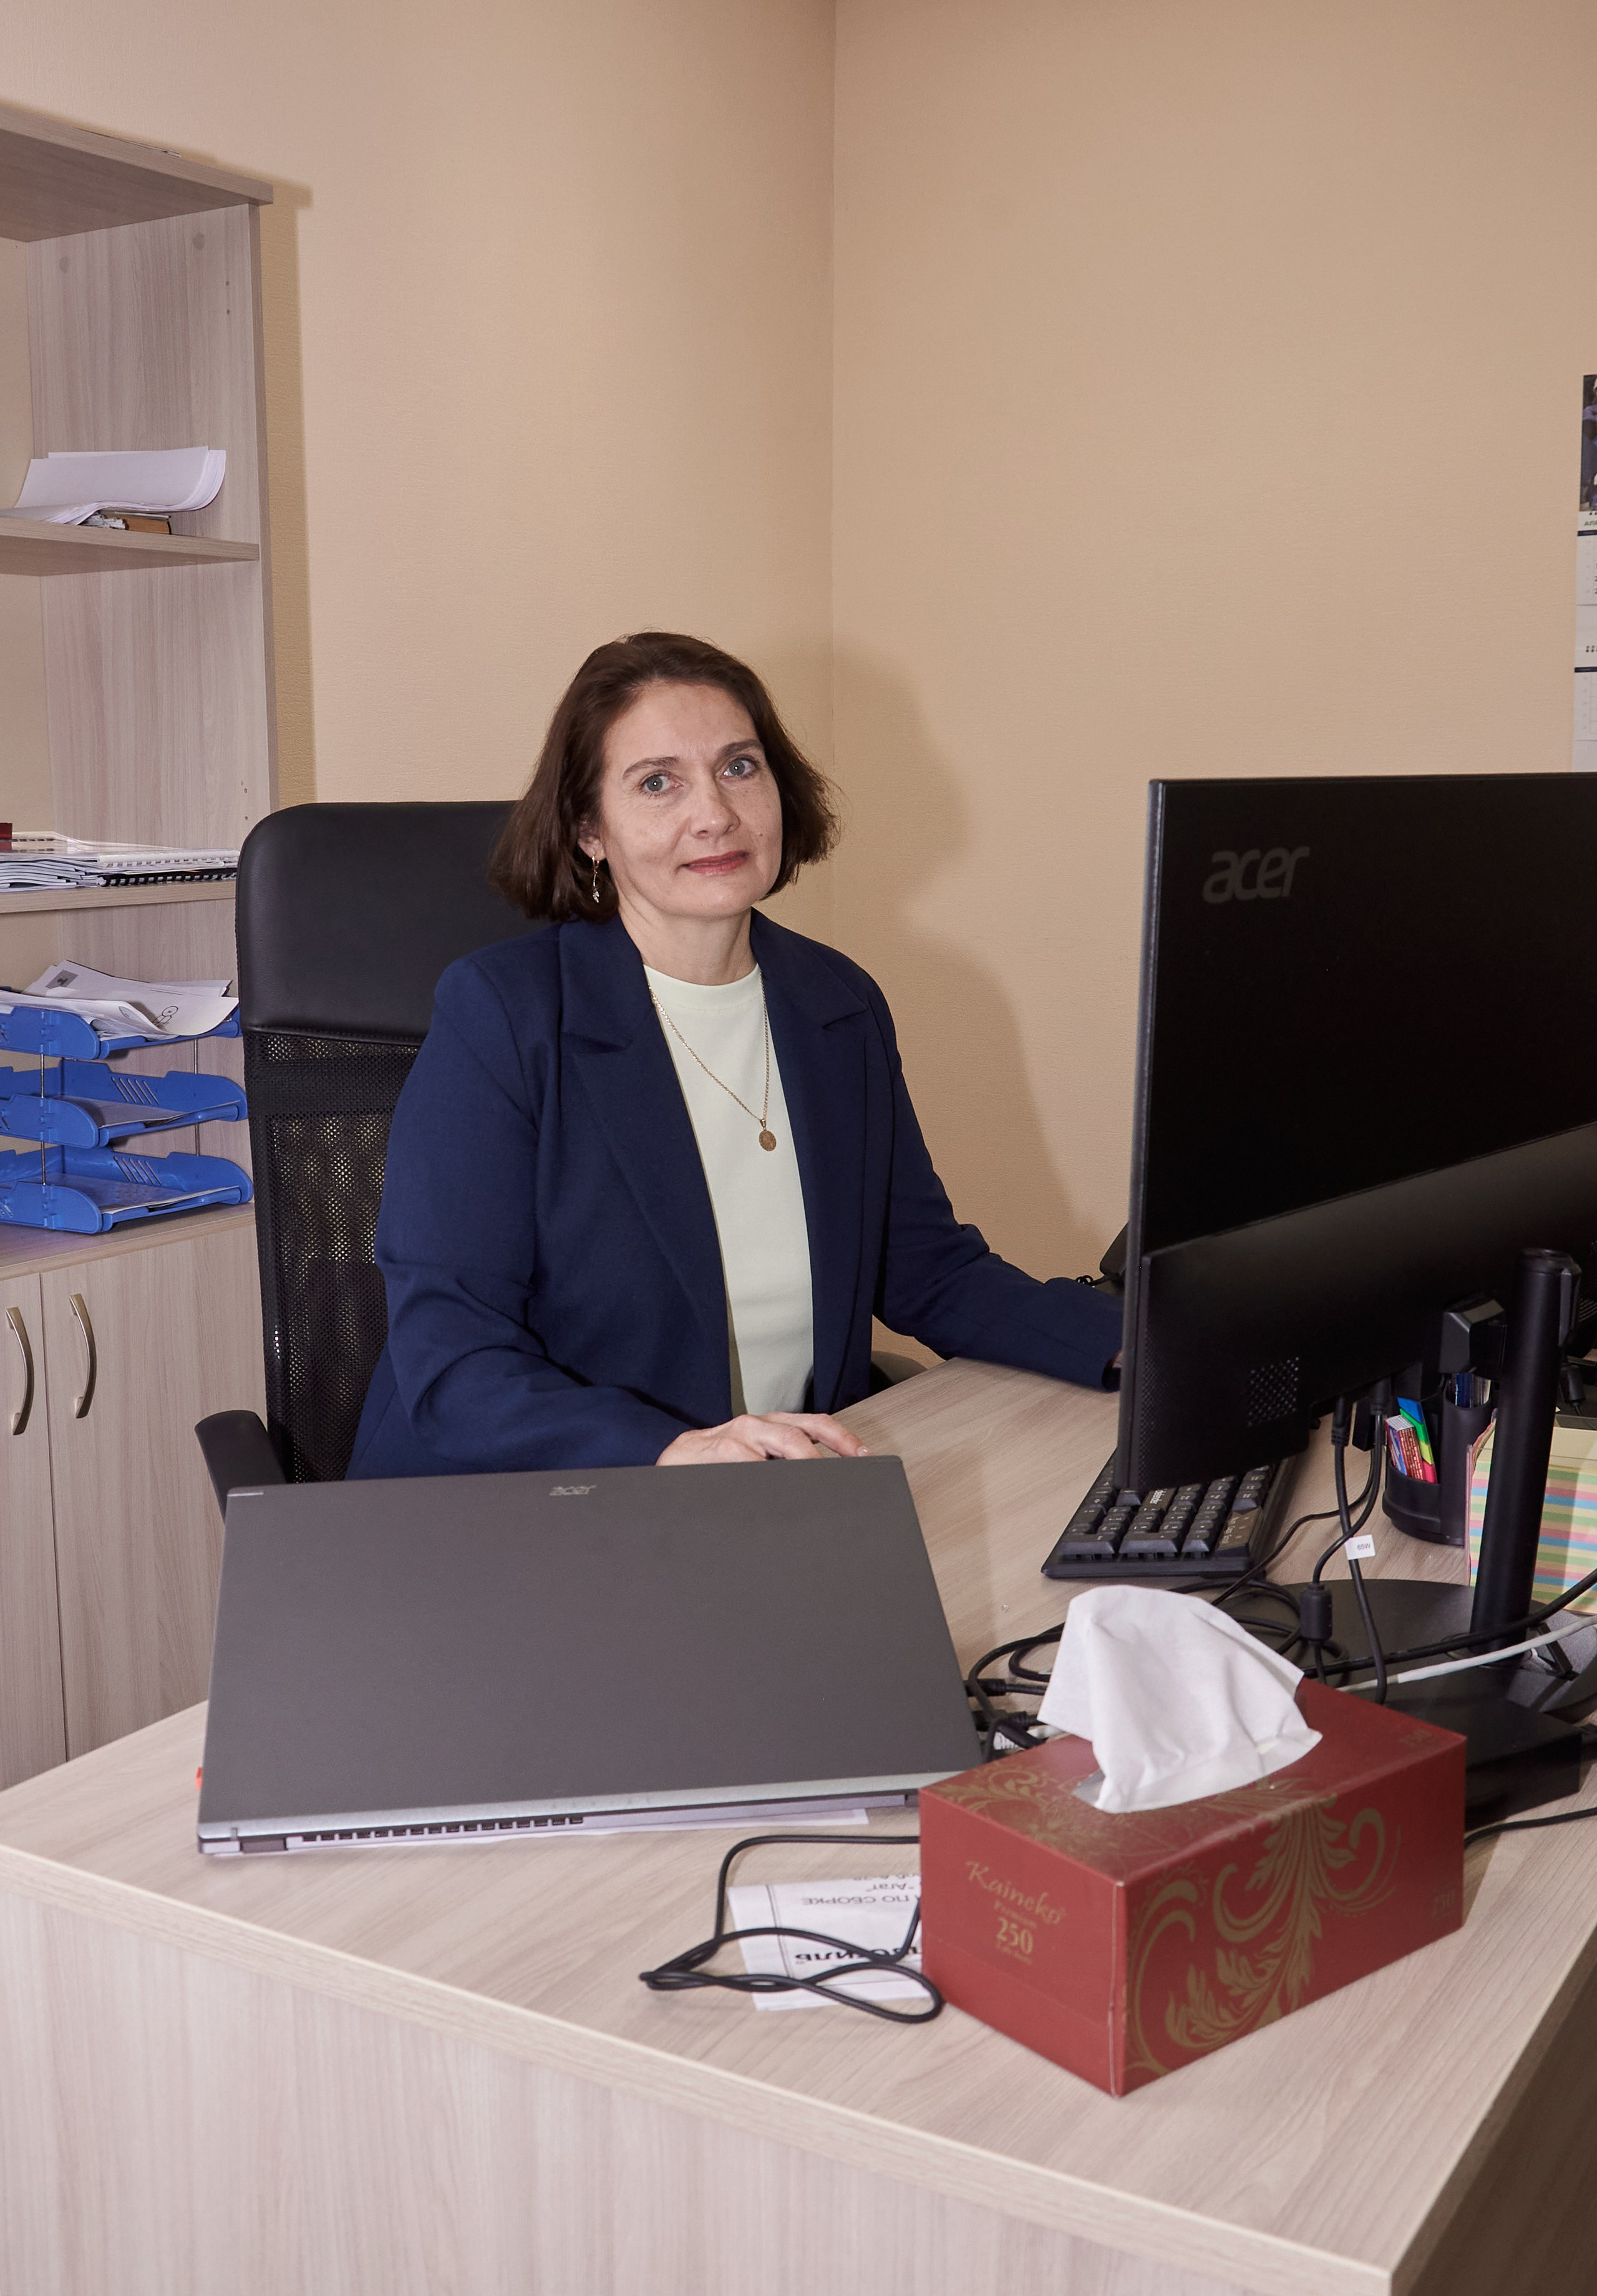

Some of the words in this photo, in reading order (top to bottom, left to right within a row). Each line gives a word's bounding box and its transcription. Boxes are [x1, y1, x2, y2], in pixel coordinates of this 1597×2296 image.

[1203, 846, 1310, 904] acer
[549, 1485, 596, 1496] acer
[802, 1896, 876, 1906] СБОРКЕ
[996, 1917, 1034, 1955] 250
